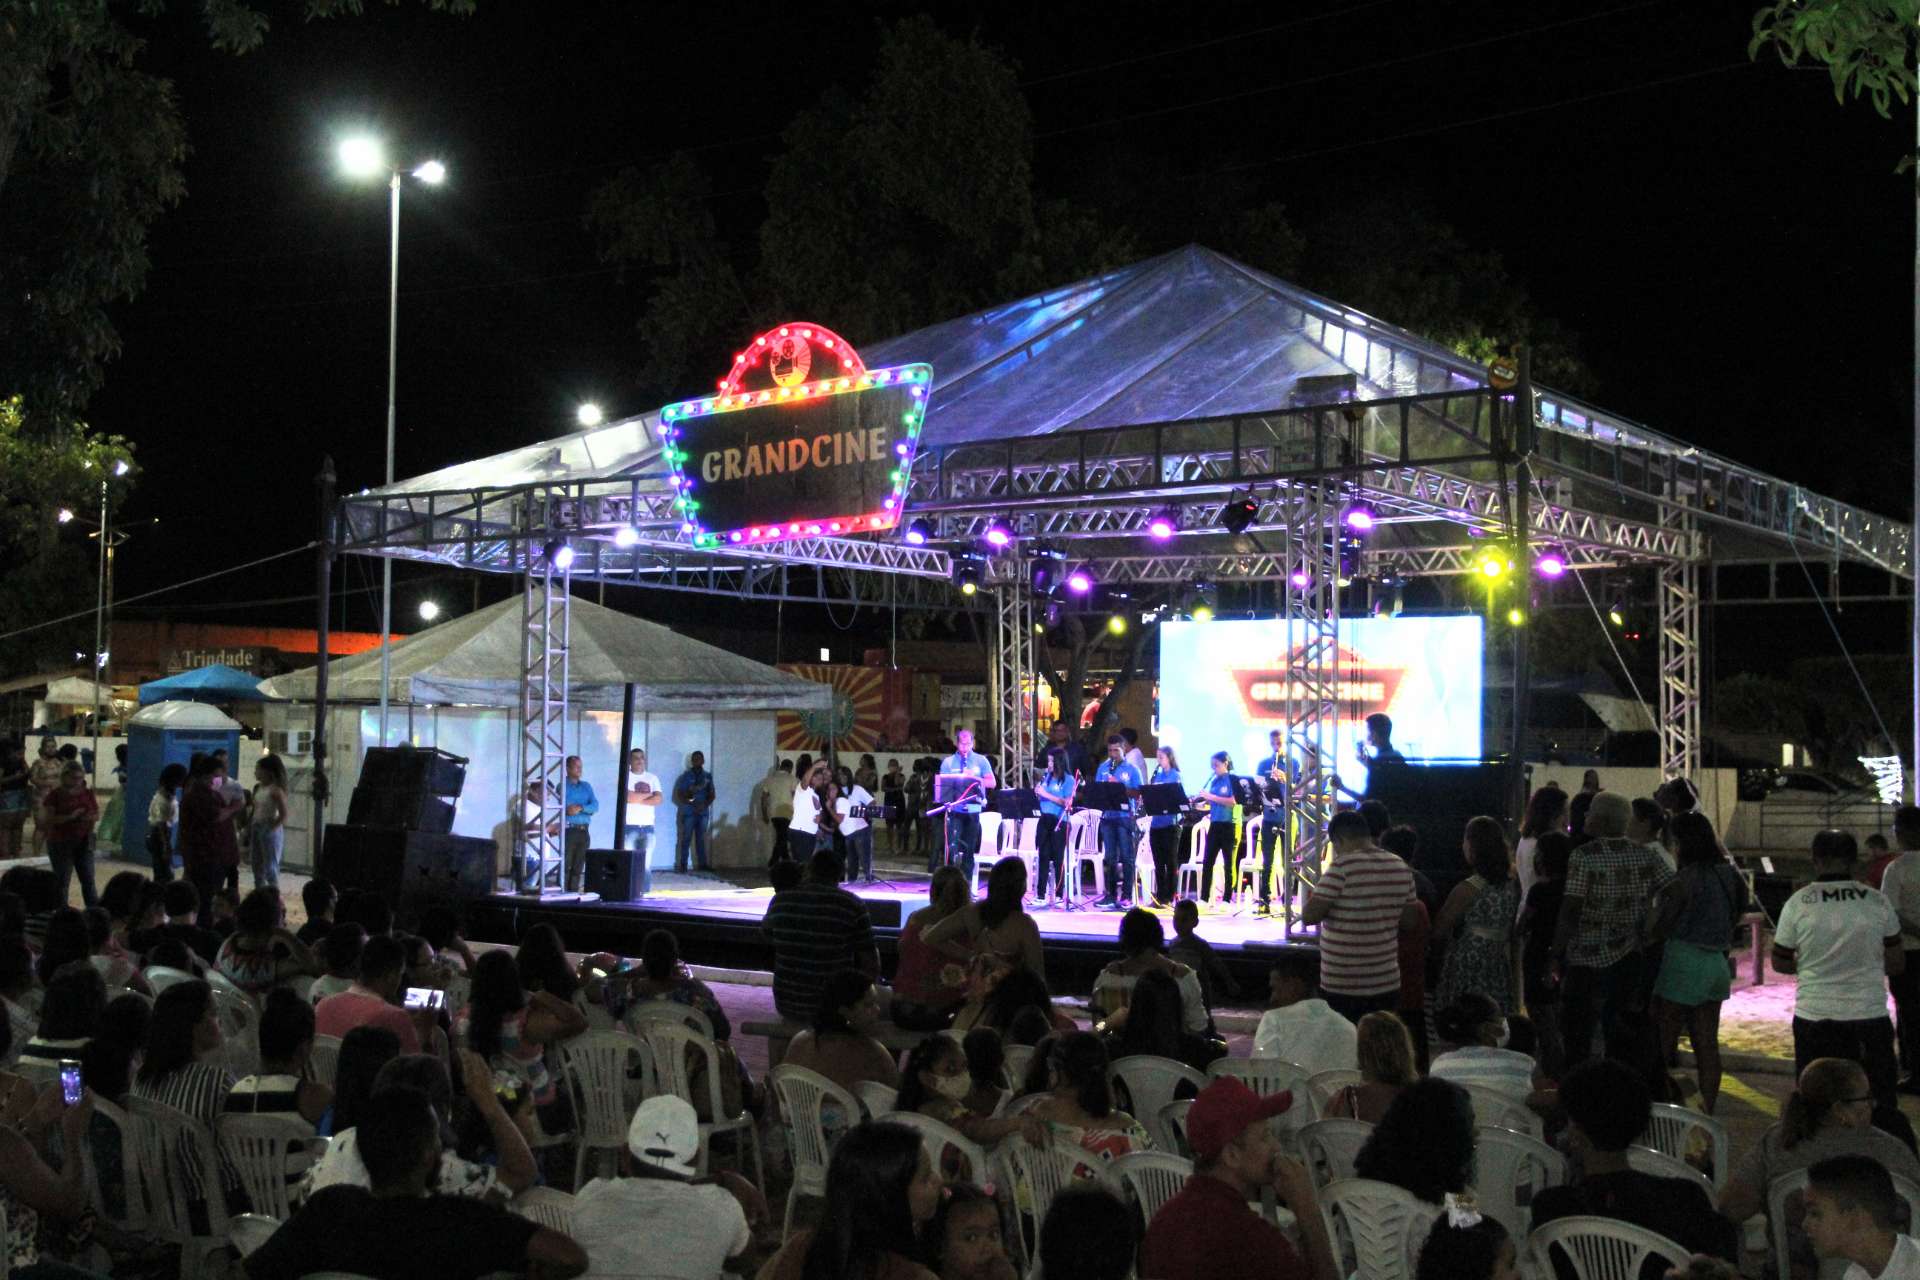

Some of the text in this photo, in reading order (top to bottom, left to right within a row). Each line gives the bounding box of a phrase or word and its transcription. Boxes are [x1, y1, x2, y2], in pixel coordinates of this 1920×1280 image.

[702, 427, 886, 483] GRANDCINE
[182, 649, 253, 668] Trindade
[1822, 888, 1868, 902] MRV
